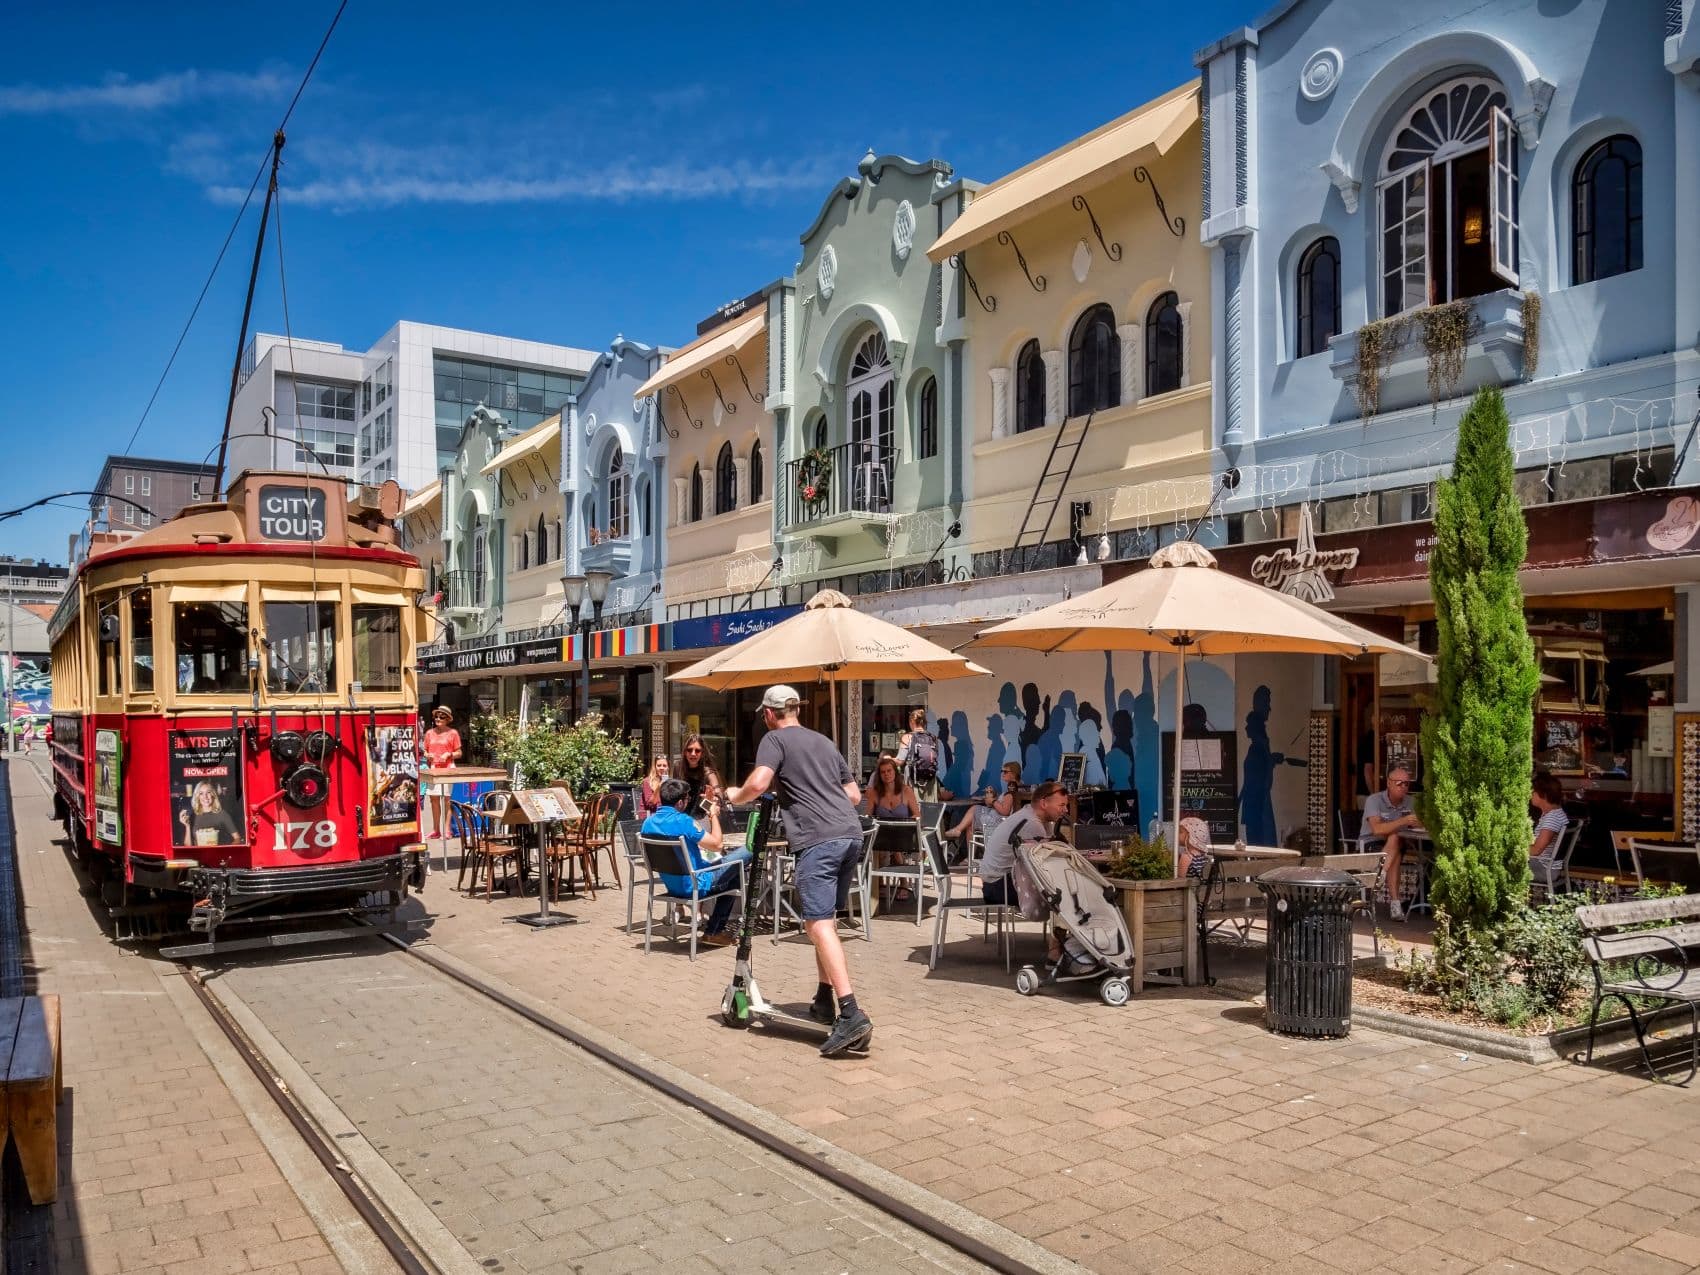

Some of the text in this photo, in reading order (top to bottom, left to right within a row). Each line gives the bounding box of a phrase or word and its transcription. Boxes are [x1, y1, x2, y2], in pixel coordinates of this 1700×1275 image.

[266, 496, 317, 515] CITY
[261, 517, 323, 537] TOUR
[1415, 538, 1426, 547] we
[1252, 551, 1355, 584] Coffee Lovers
[485, 647, 516, 666] GLASSES
[390, 729, 413, 739] NEXT
[391, 740, 414, 750] STOP
[391, 752, 415, 762] CASA
[184, 766, 228, 776] NOW OPEN
[272, 820, 338, 851] 178
